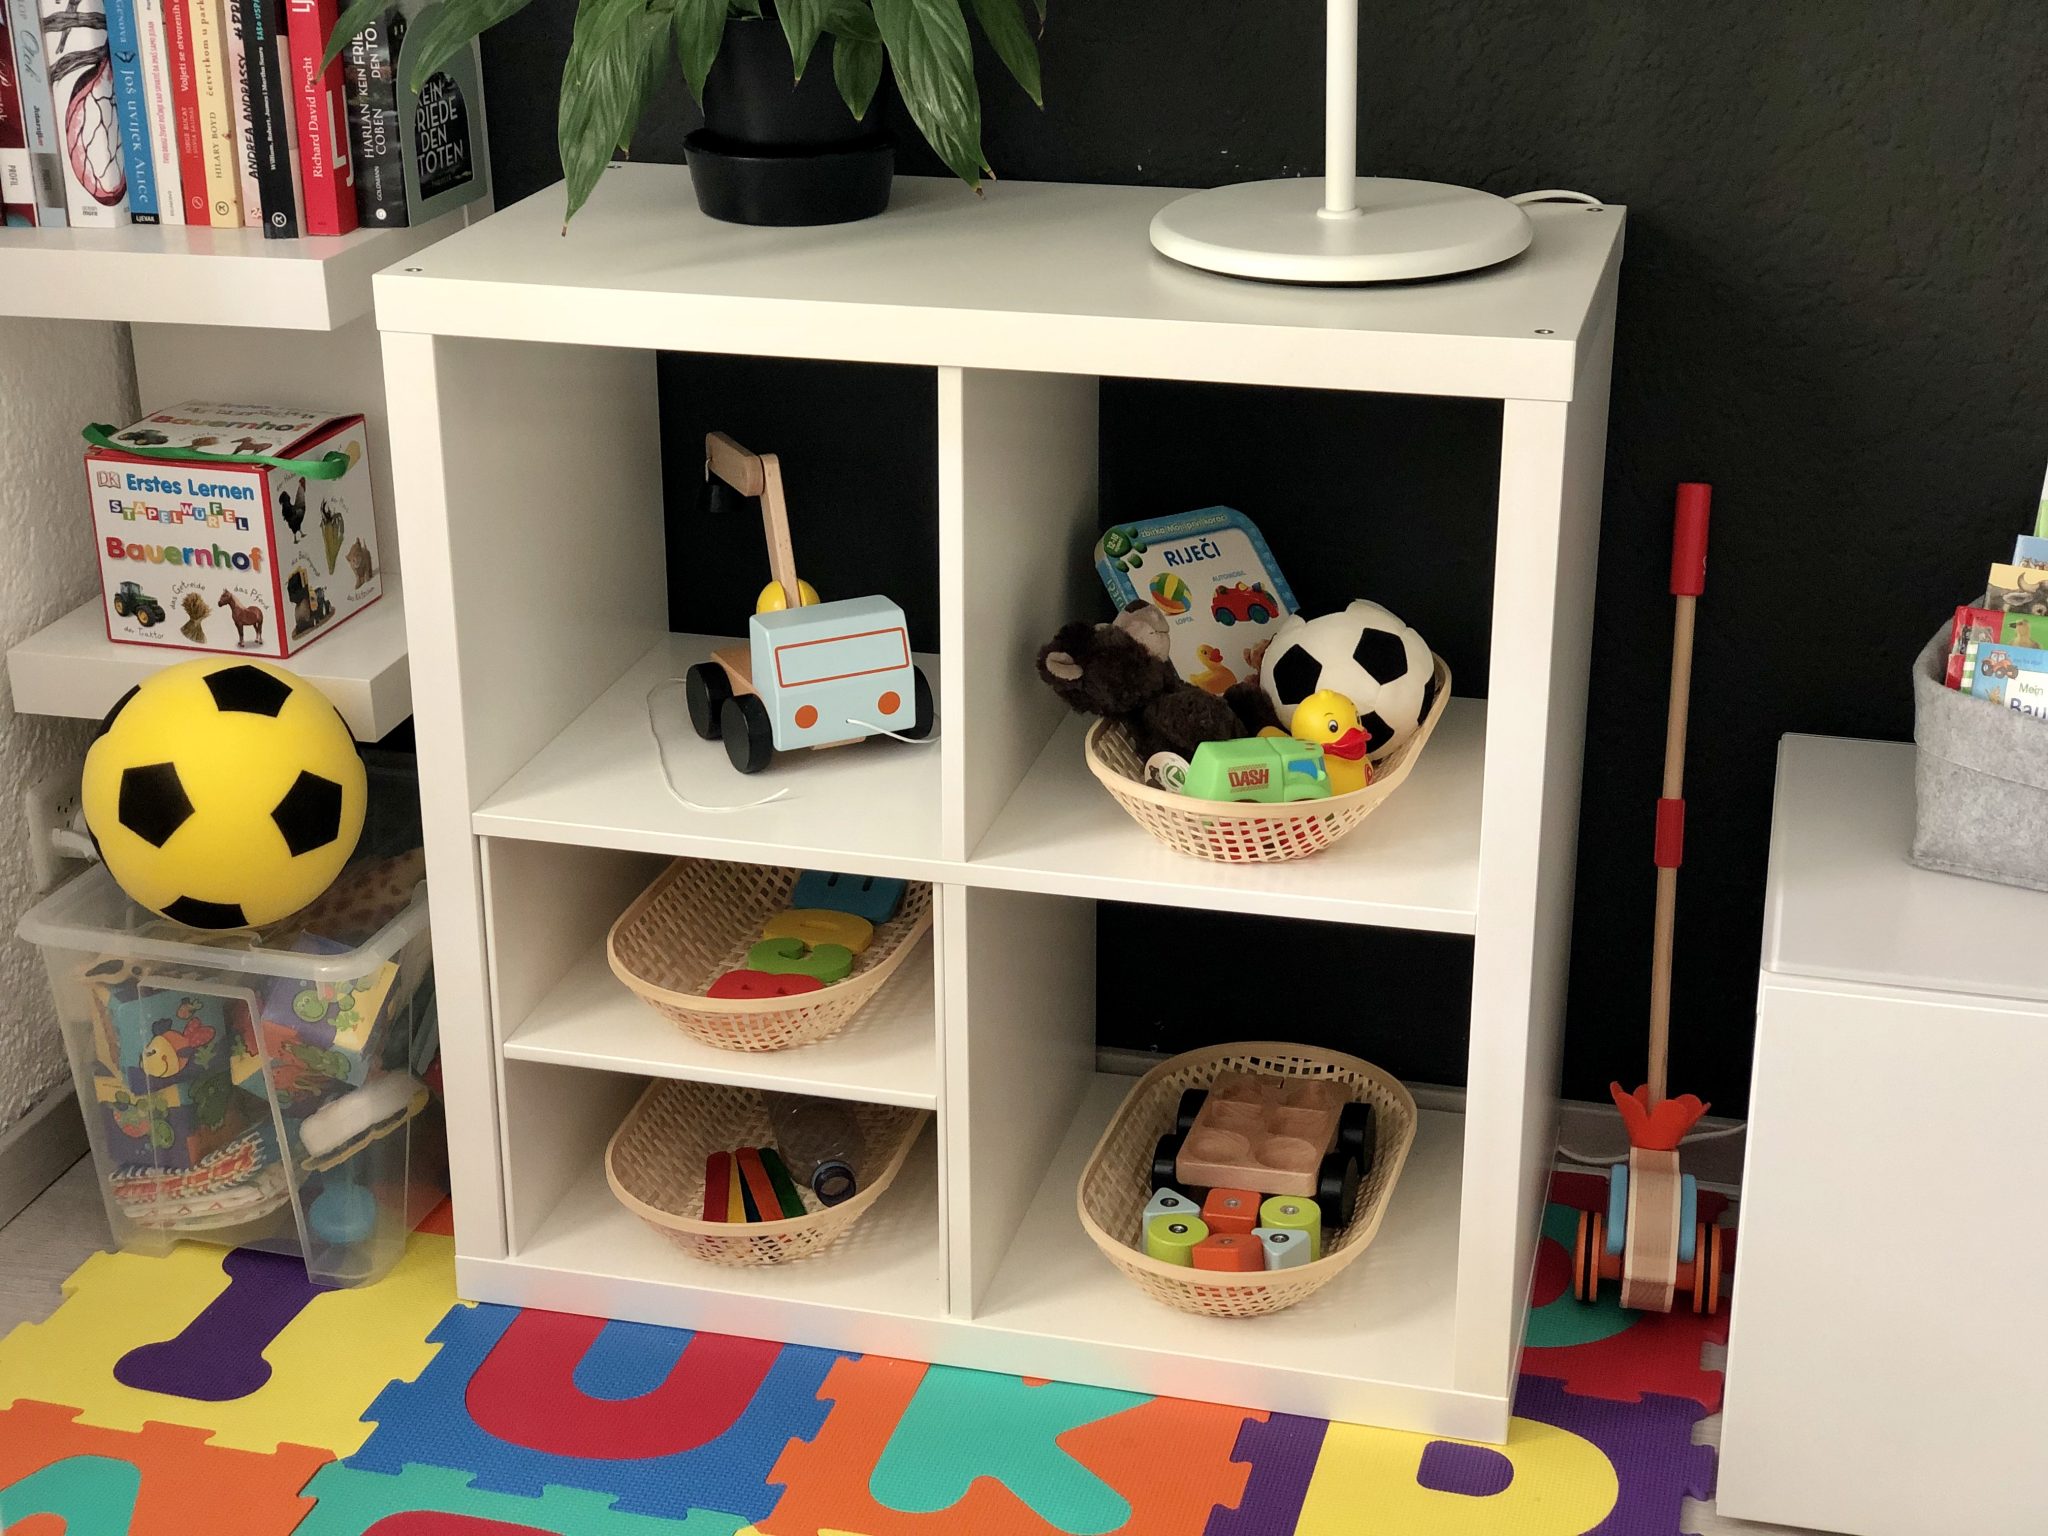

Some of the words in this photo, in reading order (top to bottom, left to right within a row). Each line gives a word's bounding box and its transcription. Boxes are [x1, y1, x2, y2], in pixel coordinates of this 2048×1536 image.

[172, 7, 184, 50] otvorenih
[178, 52, 185, 62] se
[202, 40, 214, 97] četvrtkom
[370, 53, 380, 78] DEN
[178, 63, 189, 92] Voljeti
[302, 57, 315, 93] Precht
[357, 68, 368, 96] KEIN
[210, 112, 219, 141] BOYD
[305, 96, 319, 131] David
[360, 103, 375, 158] HARLAN
[372, 108, 387, 155] COBEN
[420, 124, 448, 153] DEN
[211, 143, 222, 178] HILARY
[309, 134, 323, 178] Richard
[417, 139, 464, 176] TOTEN
[8, 165, 18, 186] PROFIL
[374, 165, 383, 201] GOLDMANN
[98, 472, 121, 488] DK
[126, 473, 182, 494] Erstes
[188, 478, 254, 501] Lernen
[106, 536, 263, 572] Bauernhof
[1163, 538, 1222, 567] RIJEČI
[172, 580, 206, 595] Getreide
[138, 628, 164, 640] Traktor
[2018, 682, 2044, 696] Mein
[1228, 768, 1270, 788] DASH
